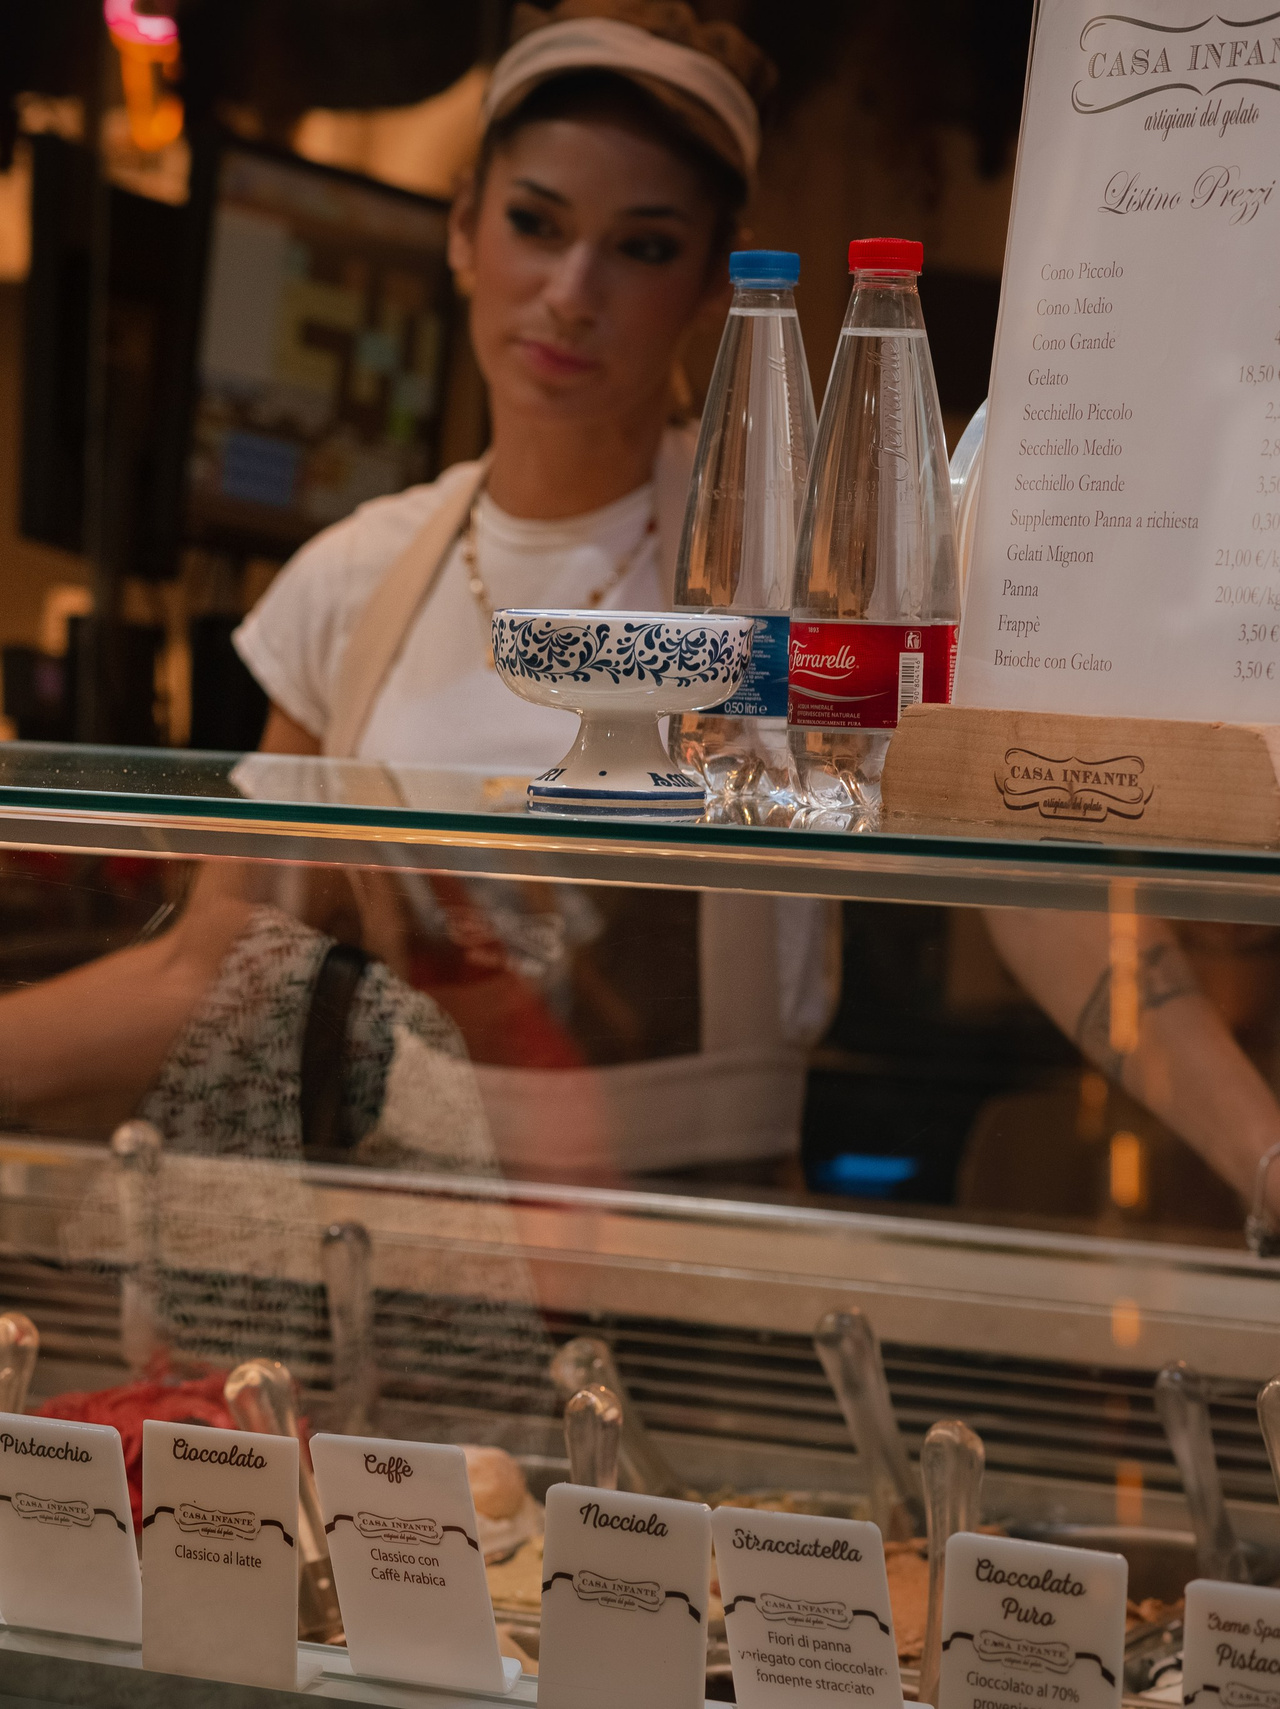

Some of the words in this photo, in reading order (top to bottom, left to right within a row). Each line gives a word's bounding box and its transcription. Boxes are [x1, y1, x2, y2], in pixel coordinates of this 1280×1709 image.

[1087, 47, 1172, 79] CASA
[1144, 107, 1196, 142] artigiani
[1200, 99, 1222, 127] del
[1218, 97, 1259, 138] gelato
[1097, 171, 1181, 215] Listino
[1190, 165, 1276, 226] Prezzi
[1040, 263, 1074, 280] Cono
[1078, 261, 1123, 279] Piccolo
[1036, 298, 1070, 316] Cono
[1074, 297, 1113, 314] Medio
[1032, 333, 1066, 351] Cono
[1070, 332, 1116, 350] Grande
[1027, 368, 1069, 385] Gelato
[1239, 364, 1274, 386] 18,50
[1022, 403, 1083, 421] Secchiello
[1087, 402, 1133, 421] Piccolo
[1018, 438, 1078, 456] Secchiello
[1083, 438, 1122, 456] Medio
[1014, 474, 1074, 492] Secchiello
[1078, 473, 1125, 492] Grande
[1010, 508, 1090, 532] Supplemento
[1094, 510, 1132, 529] Panna
[1136, 516, 1143, 528] a
[1147, 511, 1199, 529] richiesta
[1007, 544, 1043, 562] Gelati
[1046, 545, 1094, 568] Mignon
[1215, 549, 1252, 569] 21,00
[1002, 579, 1039, 597] Panna
[997, 614, 1041, 637] Frappè
[1238, 623, 1267, 645] 3,50
[1270, 623, 1279, 643] €
[789, 639, 856, 672] Ferrarelle
[993, 649, 1040, 669] Brioche
[1044, 655, 1067, 669] con
[1070, 652, 1113, 672] Gelato
[1233, 660, 1263, 683] 3,50
[1266, 661, 1275, 681] €
[744, 702, 757, 714] litri
[1010, 765, 1055, 781] CASA
[1062, 769, 1139, 787] INFANTE
[0, 1433, 92, 1463] Pistacchio
[173, 1437, 267, 1469] Cioccolato
[363, 1453, 414, 1484] Caffè
[19, 1499, 43, 1509] CASA
[47, 1503, 87, 1515] INFANTE
[182, 1511, 207, 1521] CASA
[211, 1514, 253, 1526] INFANTE
[362, 1518, 387, 1528] CASA
[391, 1521, 435, 1532] INFANTE
[579, 1503, 668, 1537] Nocciola
[175, 1544, 220, 1563] Classico
[223, 1550, 233, 1565] al
[236, 1551, 262, 1568] latte
[732, 1528, 863, 1562] Stracciatella
[370, 1548, 416, 1565] Classico
[418, 1555, 440, 1567] con
[371, 1567, 401, 1582] Caffè
[403, 1570, 446, 1587] Arabica
[582, 1578, 608, 1589] CASA
[612, 1583, 657, 1597] INFANTE
[976, 1557, 1087, 1597] Cioccolato
[797, 1604, 844, 1616] INFANTE
[1001, 1597, 1056, 1627] Puro
[767, 1630, 795, 1646] Fiori
[797, 1634, 809, 1649] di
[812, 1638, 851, 1653] panna
[798, 1657, 821, 1670] con
[966, 1670, 1034, 1696] Cioccolato
[1036, 1683, 1048, 1698] al
[1051, 1685, 1080, 1703] 70%
